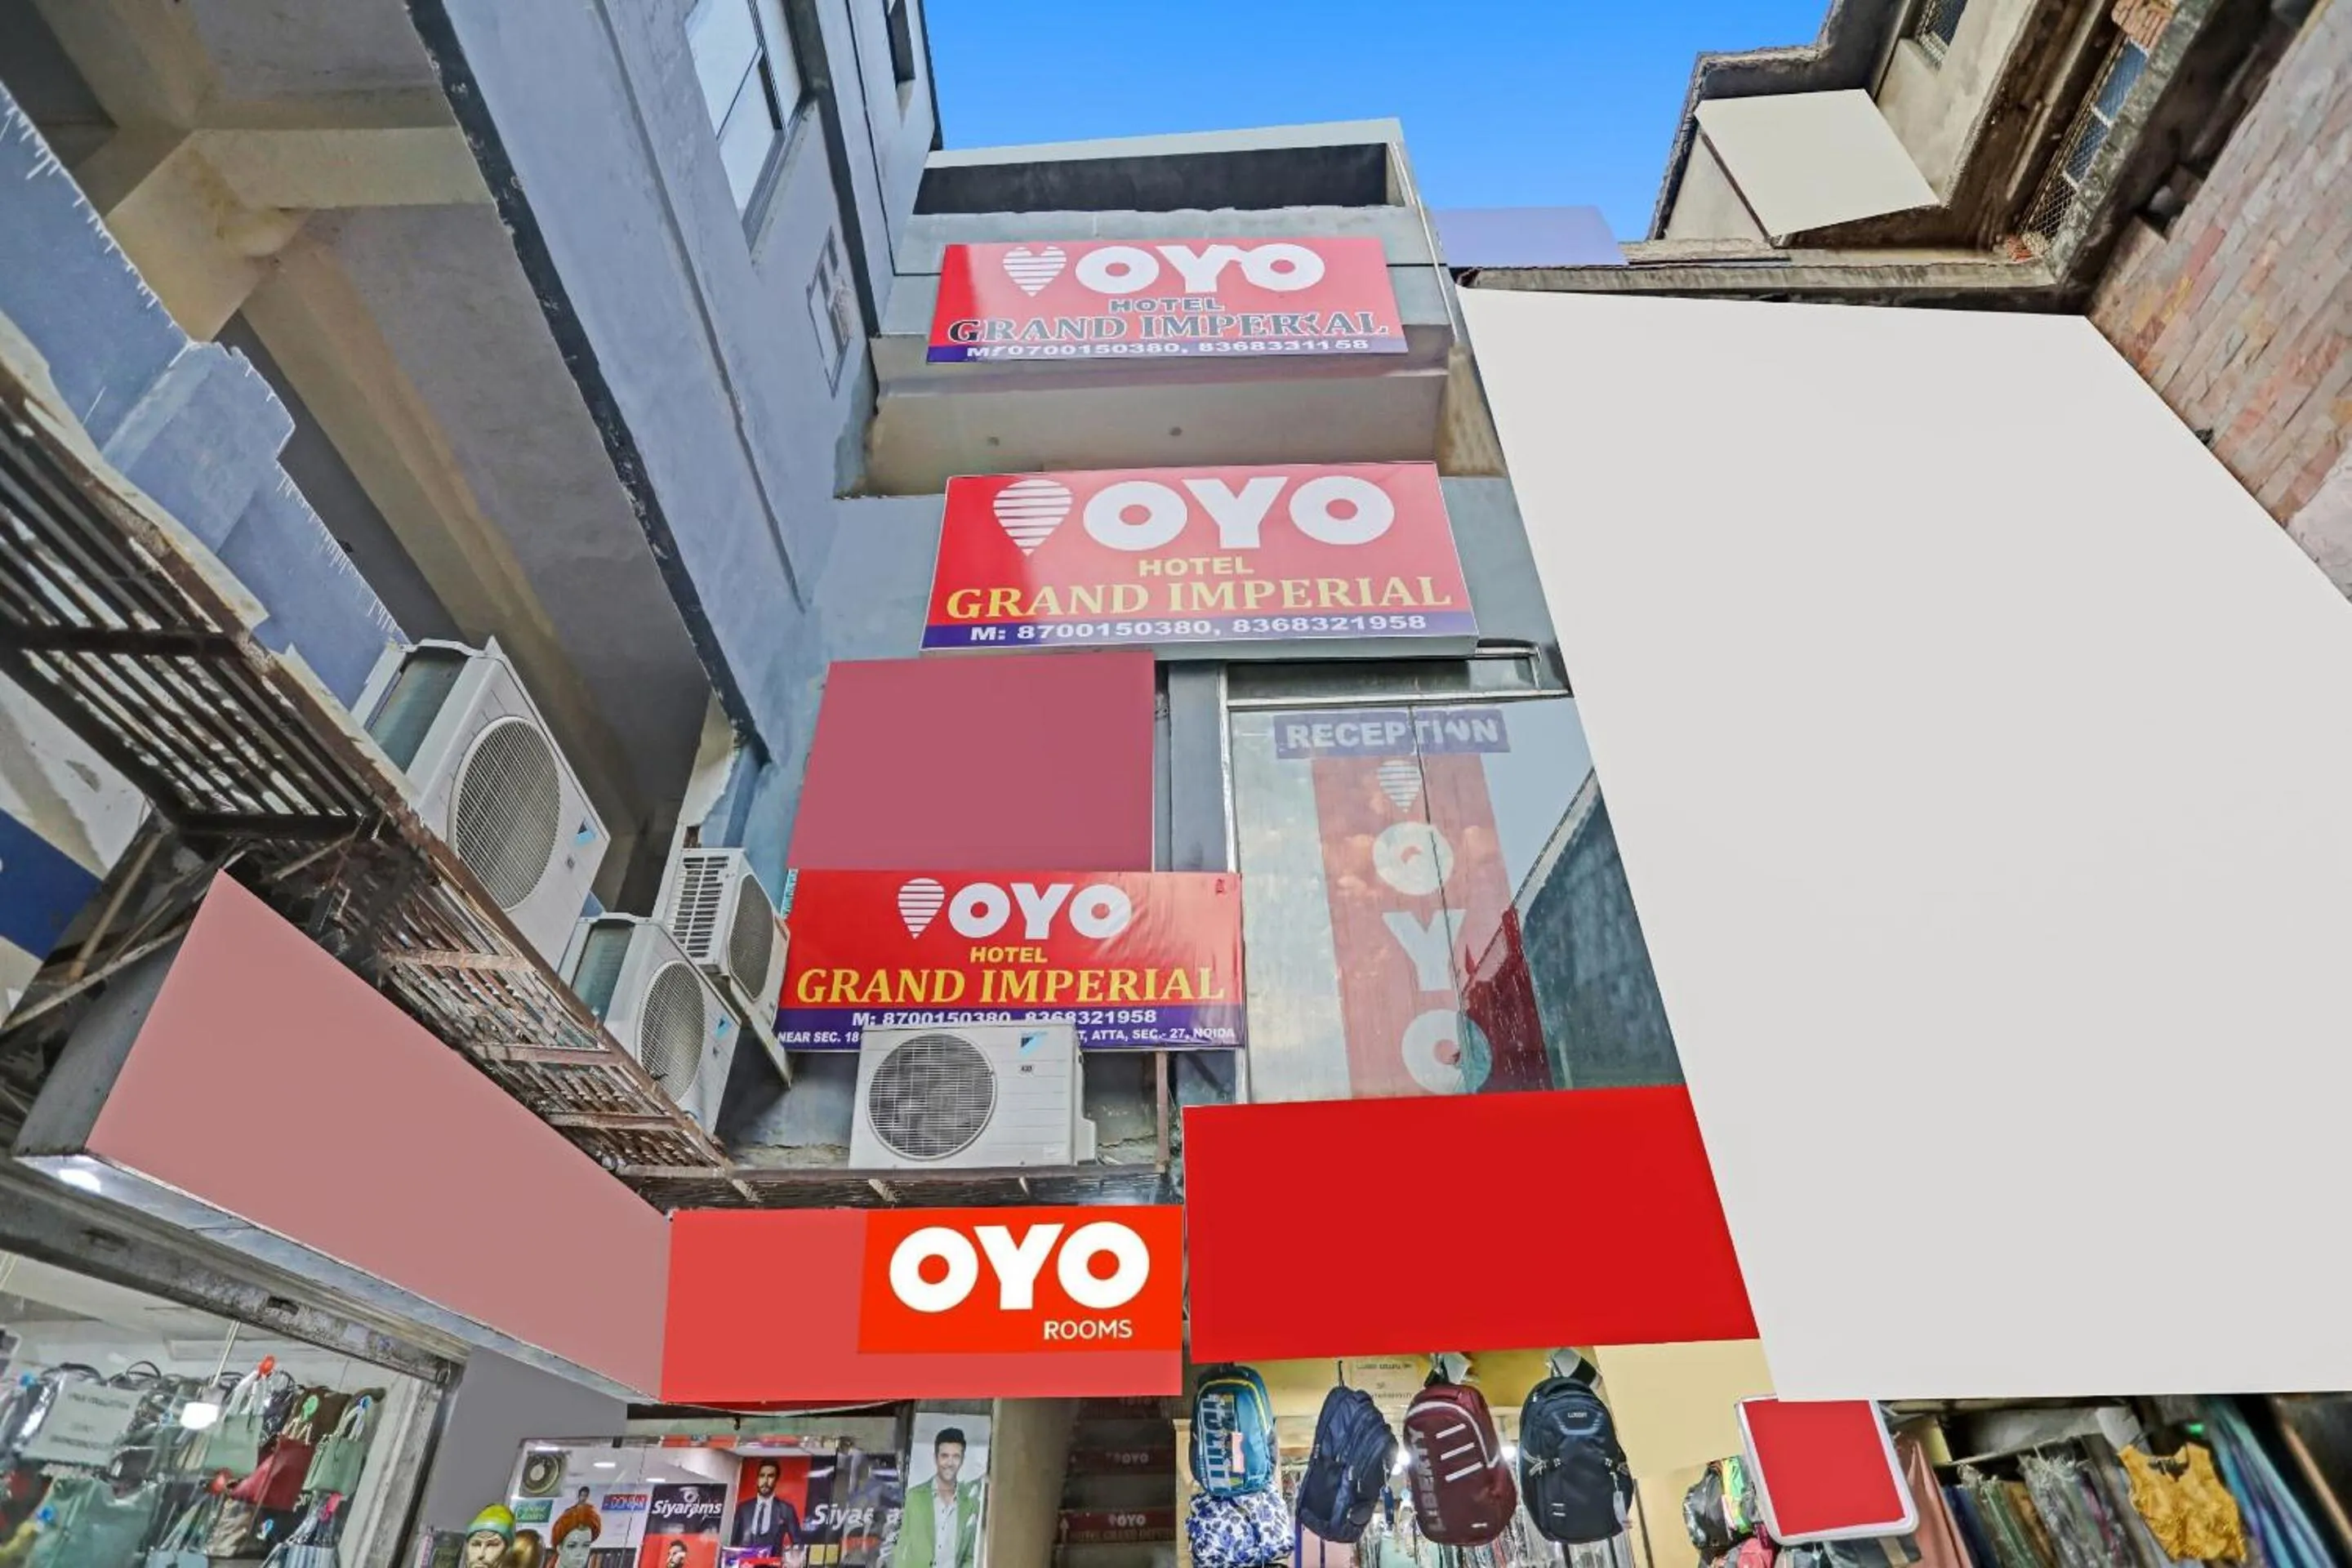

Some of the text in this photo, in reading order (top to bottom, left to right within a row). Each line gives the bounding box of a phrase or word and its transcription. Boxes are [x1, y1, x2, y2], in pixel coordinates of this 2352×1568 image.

[1076, 243, 1325, 293] OYO
[1109, 297, 1225, 313] HOTEL
[947, 316, 1127, 344] GRAND
[1083, 475, 1395, 551] OYO
[1138, 556, 1255, 577] HOTEL
[947, 577, 1452, 619] GRAND IMPERIAL
[970, 615, 1427, 641] M: 8700150380, 8368321958
[948, 882, 1132, 940] OYO
[969, 947, 1048, 964] HOTEL
[1373, 822, 1493, 1094] OYO
[797, 966, 1224, 1004] GRAND IMPERIAL
[852, 1012, 875, 1027] M:
[777, 1031, 811, 1043] NEAR
[813, 1031, 841, 1043] SEC.
[1091, 1029, 1129, 1042] ATTA,
[889, 1221, 1150, 1313] OYO
[1043, 1319, 1134, 1340] ROOMS
[653, 1499, 723, 1518] Siyarams
